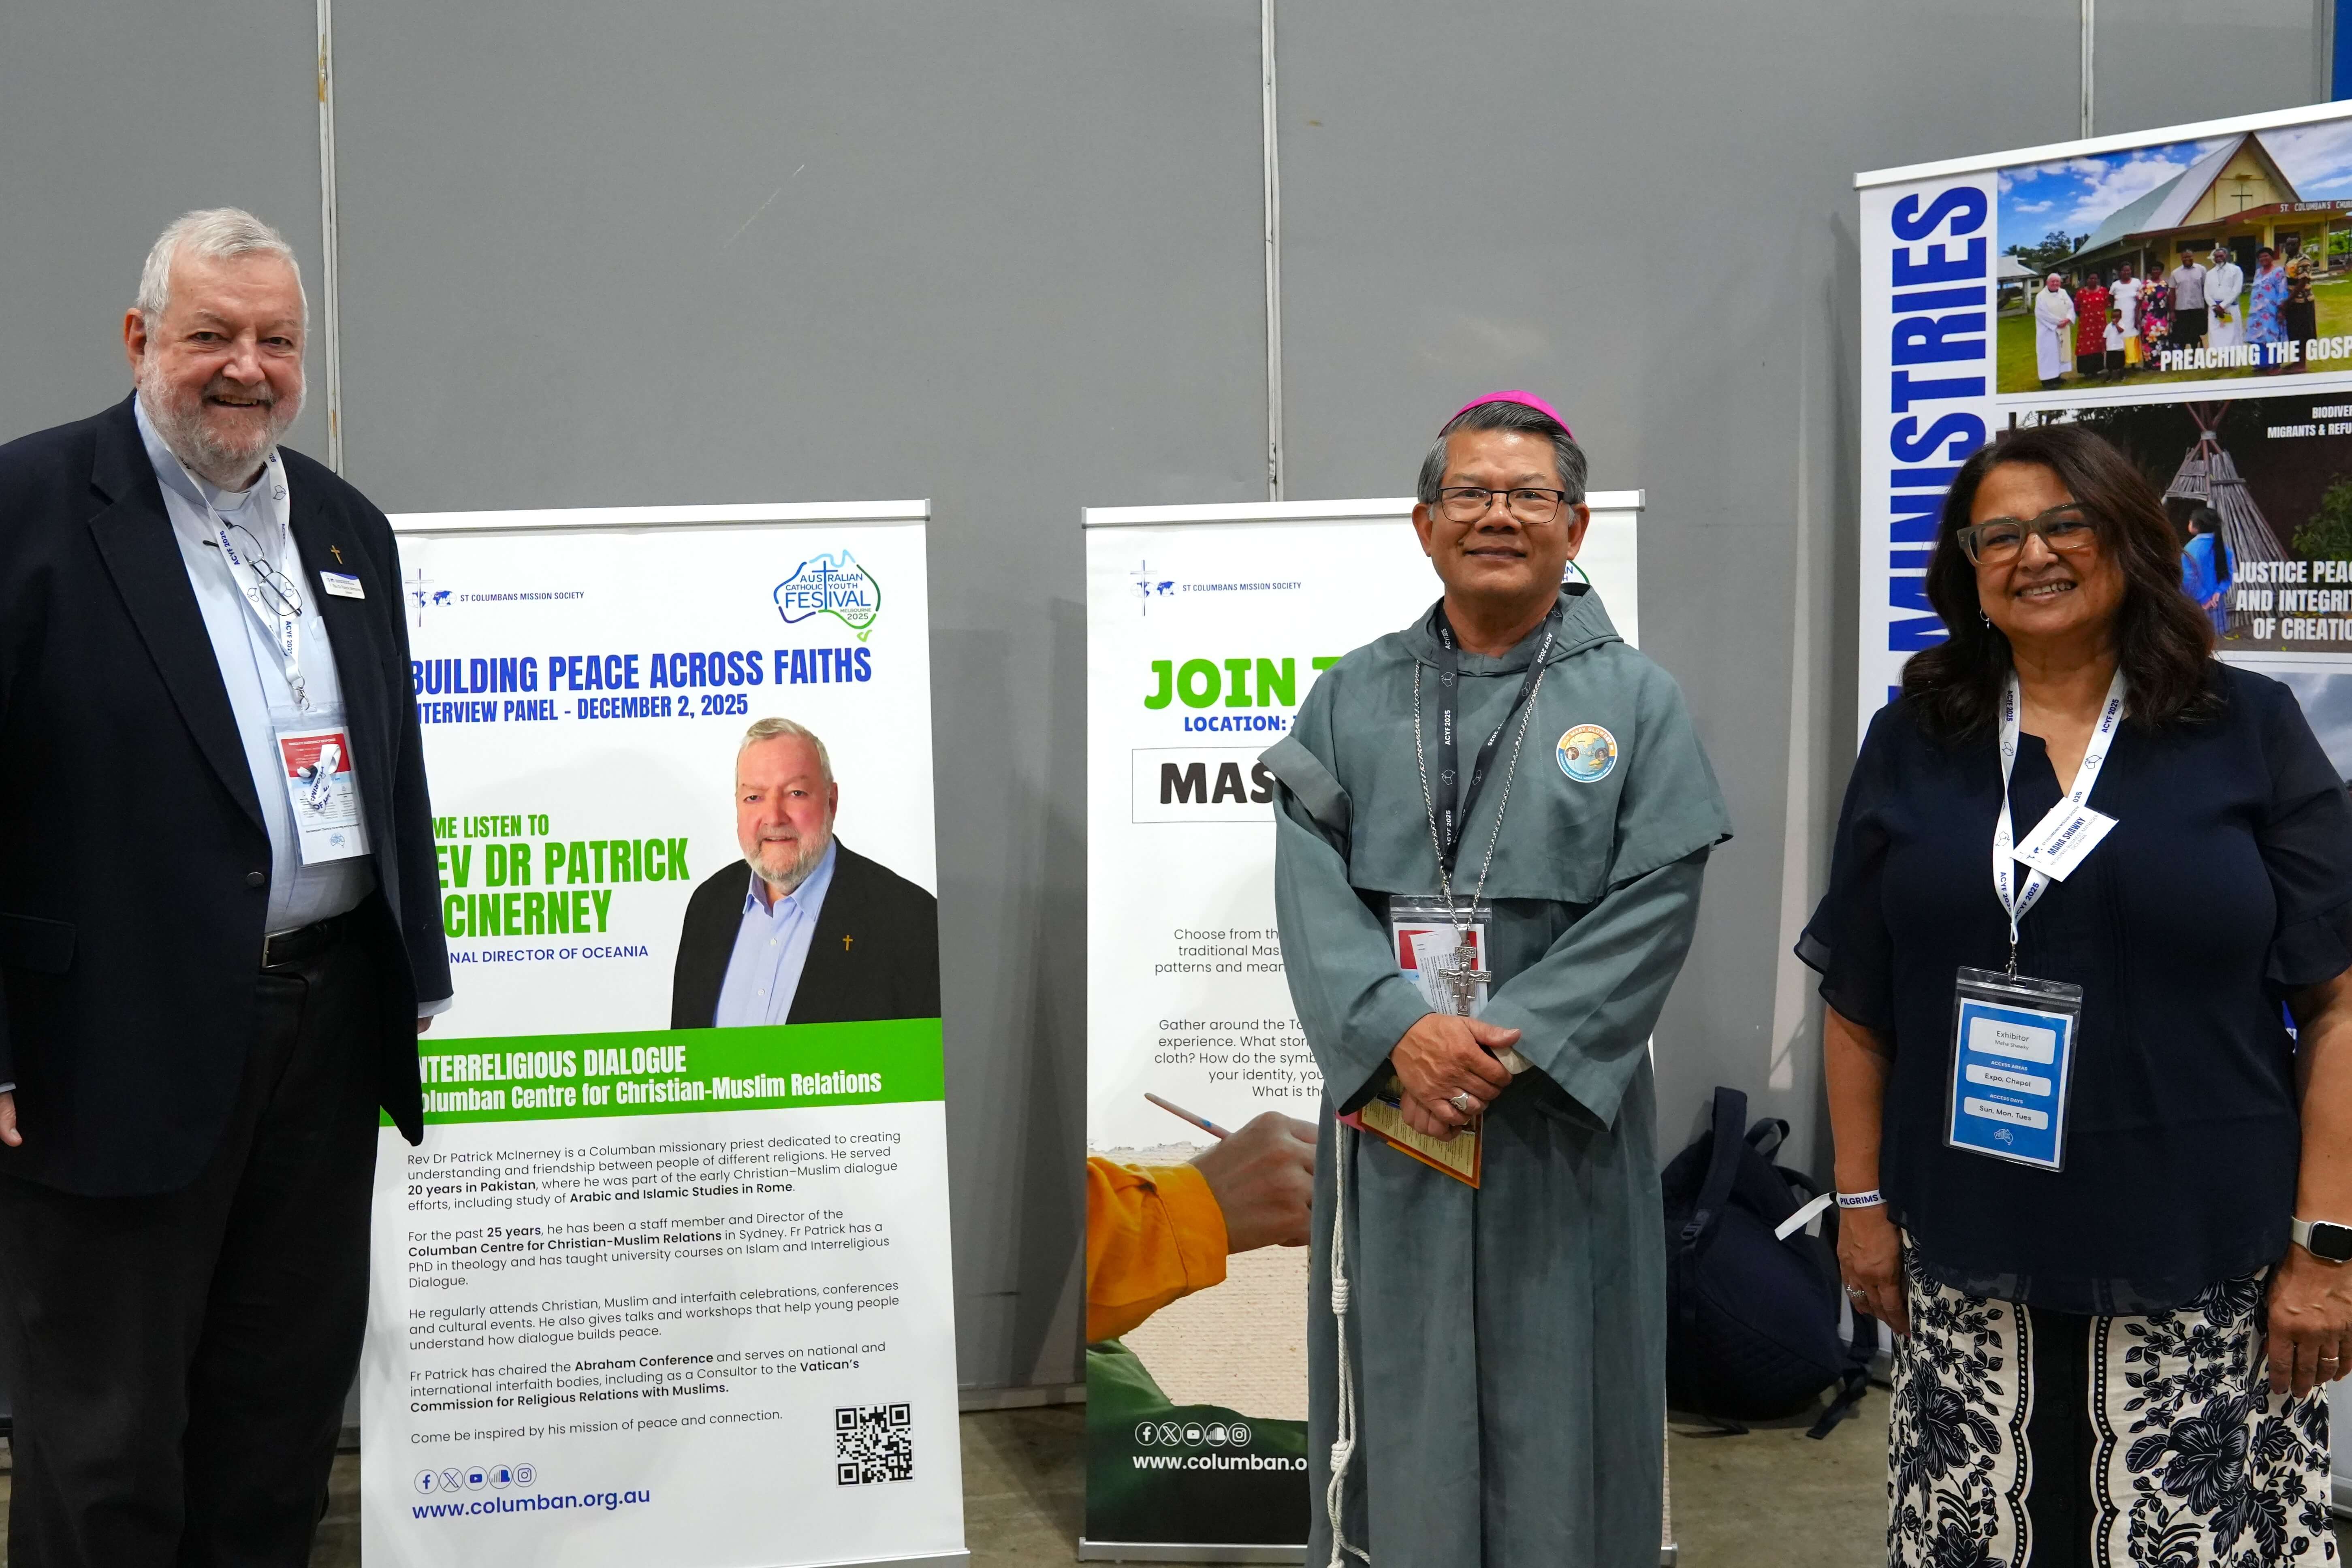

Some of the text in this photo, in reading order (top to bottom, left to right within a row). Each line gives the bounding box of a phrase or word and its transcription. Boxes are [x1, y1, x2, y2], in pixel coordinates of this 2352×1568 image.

[2160, 342, 2260, 371] PREACHING
[2266, 340, 2300, 364] THE
[2267, 425, 2316, 438] MIGRANTS
[2318, 425, 2326, 435] &
[220, 530, 240, 565] ACYF 2025
[2233, 561, 2307, 583] JUSTICE
[785, 591, 871, 608] FESTIVAL
[2235, 589, 2273, 611] AND
[2253, 618, 2276, 640] OF
[1537, 632, 1553, 664] ACYF 2025
[411, 648, 871, 695] BUILDING PEACE ACROSS FAITHS
[1145, 658, 1296, 710] JOIN
[417, 702, 497, 723] TERVIEW
[505, 700, 557, 721] PANEL
[578, 696, 671, 719] DECEMBER
[678, 695, 694, 717] 2,
[702, 694, 747, 715] 2025
[2101, 698, 2119, 733] ACYF 2025
[1185, 716, 1285, 732] LOCATION:
[1488, 730, 1498, 746] 2025
[1571, 727, 1612, 743] MARY GLOWREY
[1160, 762, 1276, 804] MAS
[2073, 791, 2083, 804] 025
[2060, 816, 2071, 827] MISSION
[2070, 806, 2080, 816] SOCIETY
[432, 814, 549, 838] ME LISTEN TO
[2047, 817, 2086, 855] MAHA SHAWKY
[2051, 814, 2099, 866] REGIONAL BUSINESS MANAGER
[2071, 834, 2087, 850] OCEANIA
[436, 838, 689, 888] EV DR PATRICK
[2025, 882, 2039, 901] 2025
[444, 890, 611, 937] CINERNEY
[1174, 928, 1278, 939] Choose from th
[482, 949, 555, 962] DIRECTOR
[559, 948, 577, 959] OF
[582, 946, 648, 958] OCEANIA
[1179, 945, 1281, 956] traditional Mas
[1156, 963, 1211, 975] patterns
[1216, 962, 1242, 972] and
[1159, 1020, 1206, 1030] Gather
[1210, 1019, 1258, 1030] around
[1264, 1019, 1285, 1029] the
[1159, 1036, 1236, 1050] experience.
[1240, 1036, 1276, 1046] What
[1996, 1030, 2030, 1042] Exhibitor
[2010, 1043, 2029, 1051] Shawky
[419, 1046, 686, 1083] NTERRELIGIOUS DIALOGUE
[1155, 1053, 1316, 1066] cloth? How do the symb
[1209, 1069, 1323, 1083] your identity, you
[1985, 1073, 2031, 1088] Expo, Chapel
[422, 1070, 881, 1113] olumban Centre for Christian-Muslim Relations
[1253, 1086, 1322, 1096] What is th
[1990, 1093, 2009, 1101] ACCESS
[1979, 1105, 2032, 1121] Sun, Mon, Tues
[1840, 1194, 1878, 1205] PILGRIMS
[410, 1277, 468, 1289] Dialogue.
[412, 1410, 782, 1443] Come be inspired by his mission of peace and connection.
[1133, 1454, 1307, 1470] www.columban.o
[412, 1488, 651, 1519] www.columban.org.au
